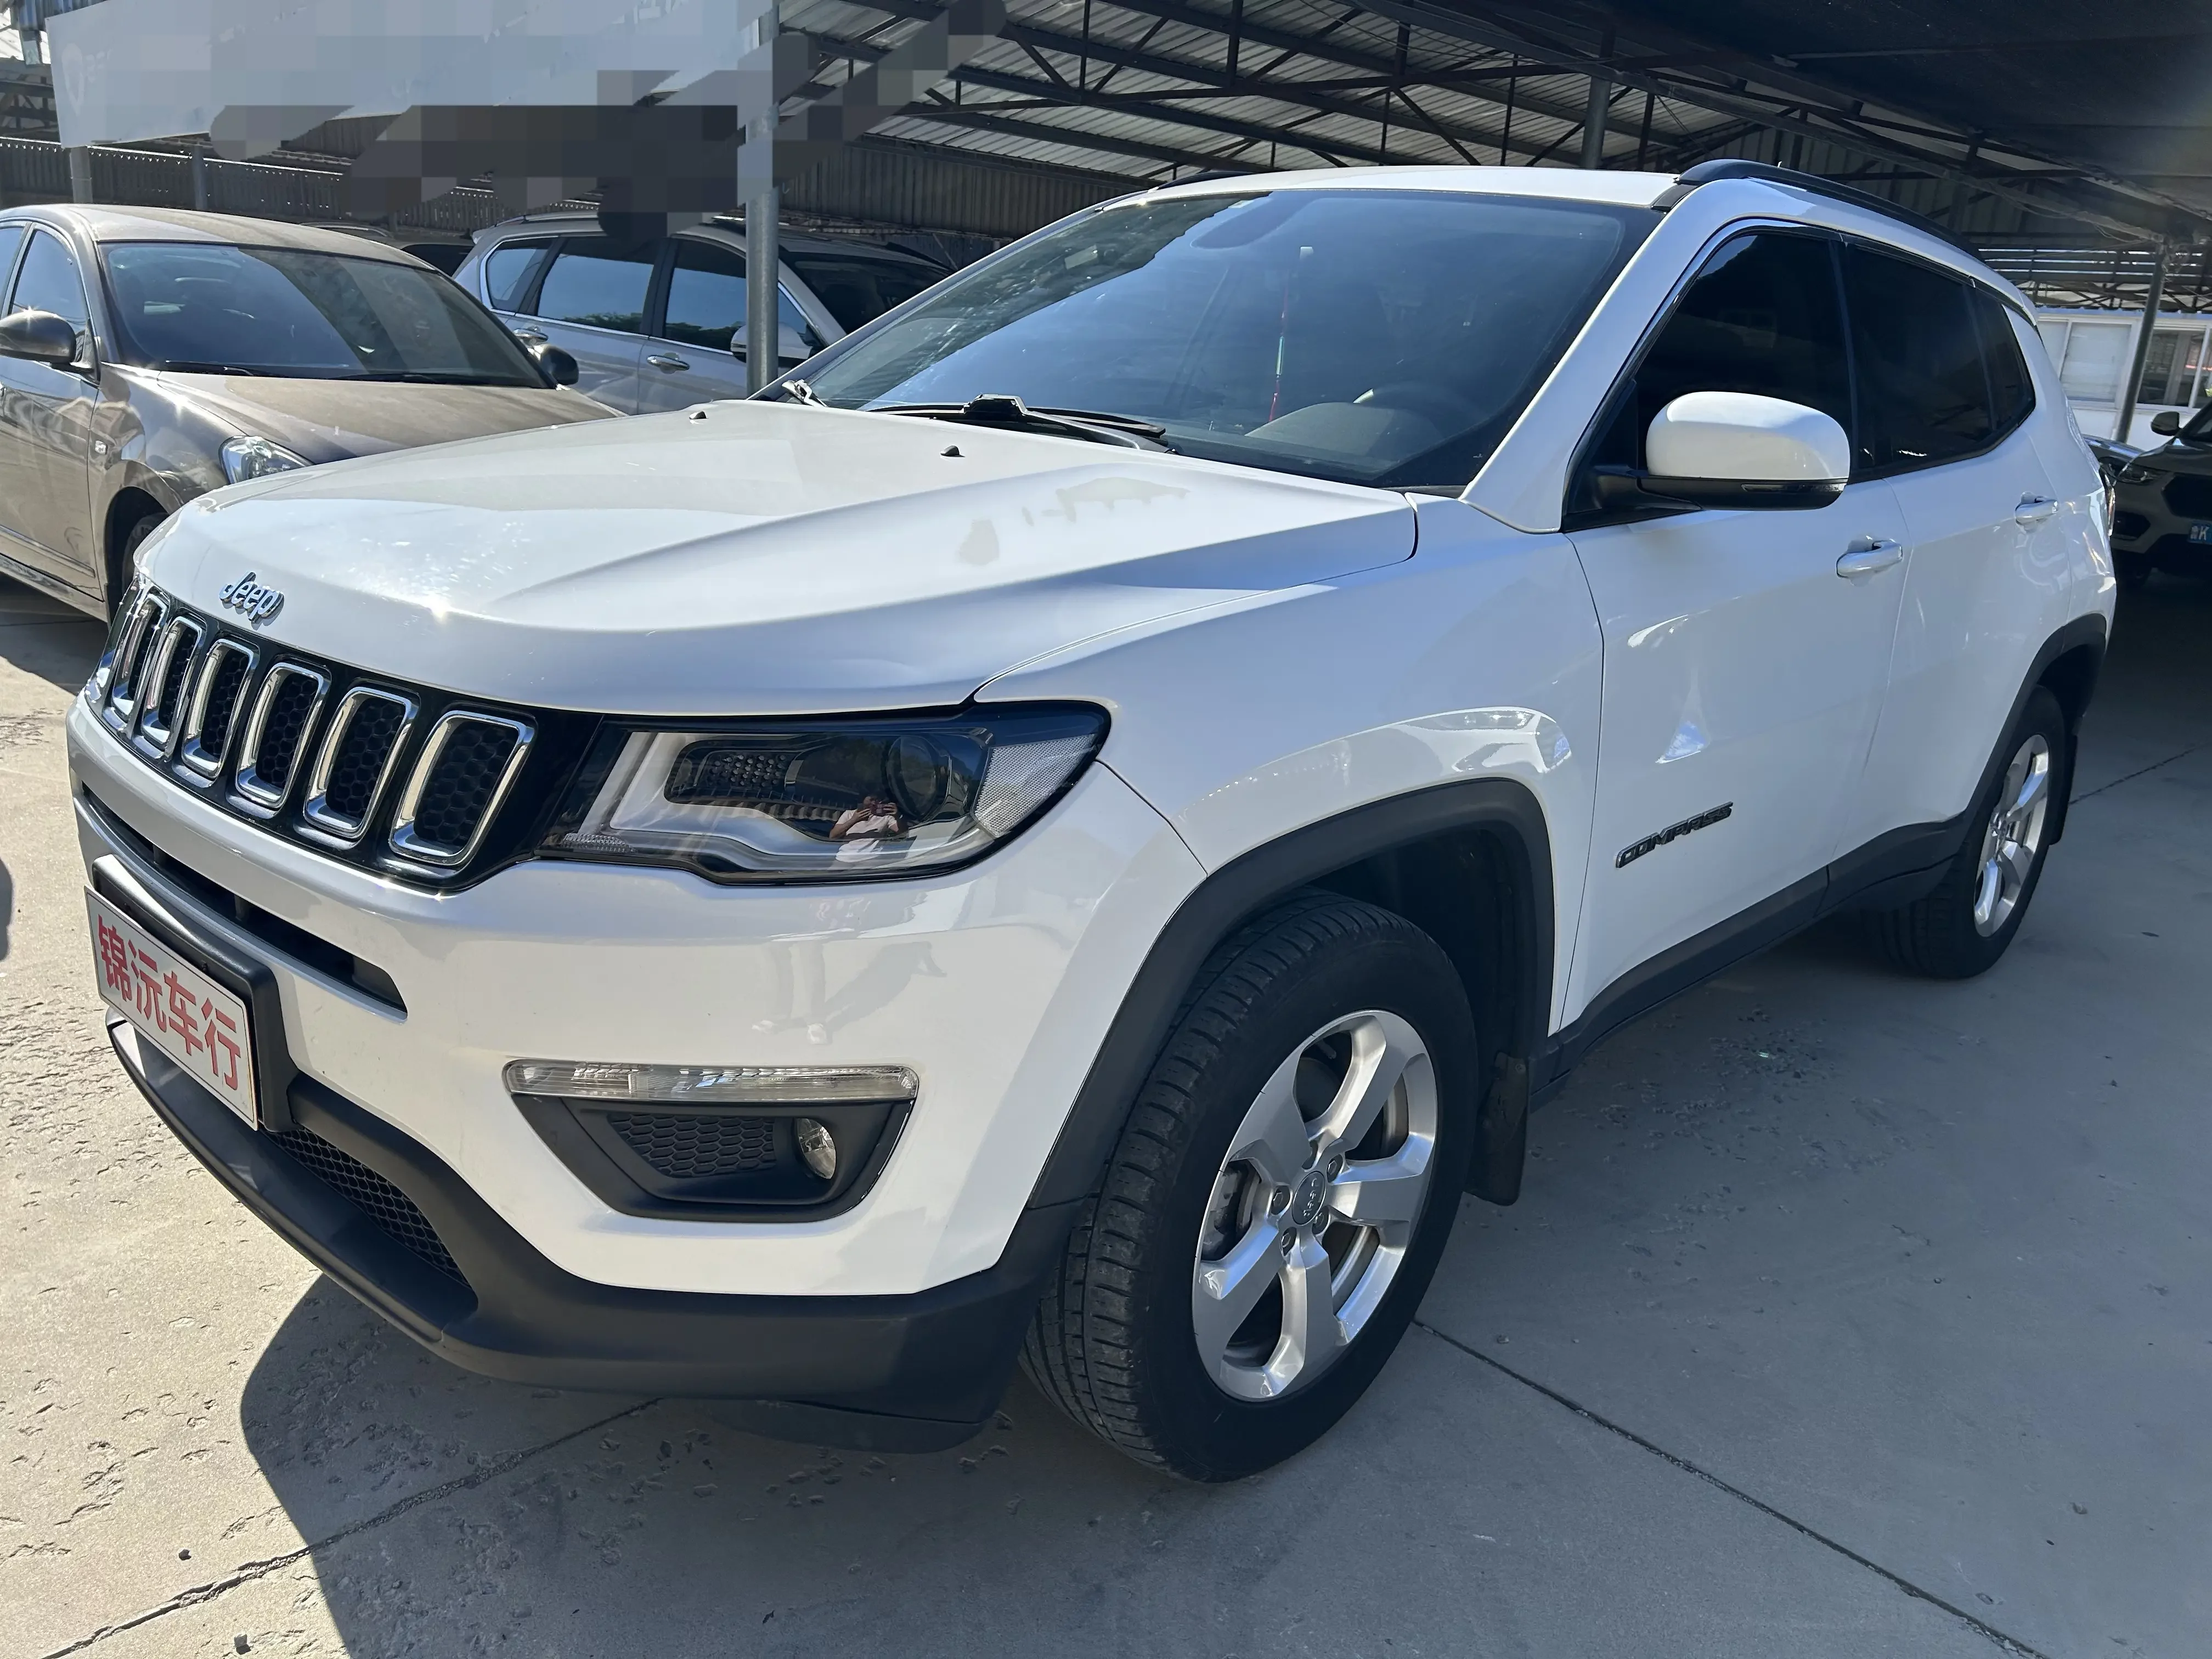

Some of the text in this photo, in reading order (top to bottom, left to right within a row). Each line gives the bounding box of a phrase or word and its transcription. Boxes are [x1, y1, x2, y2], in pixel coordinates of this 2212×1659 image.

[219, 571, 284, 623] Jeep
[1616, 802, 1734, 868] COMPASS
[98, 914, 241, 1090] 锦沅车行
